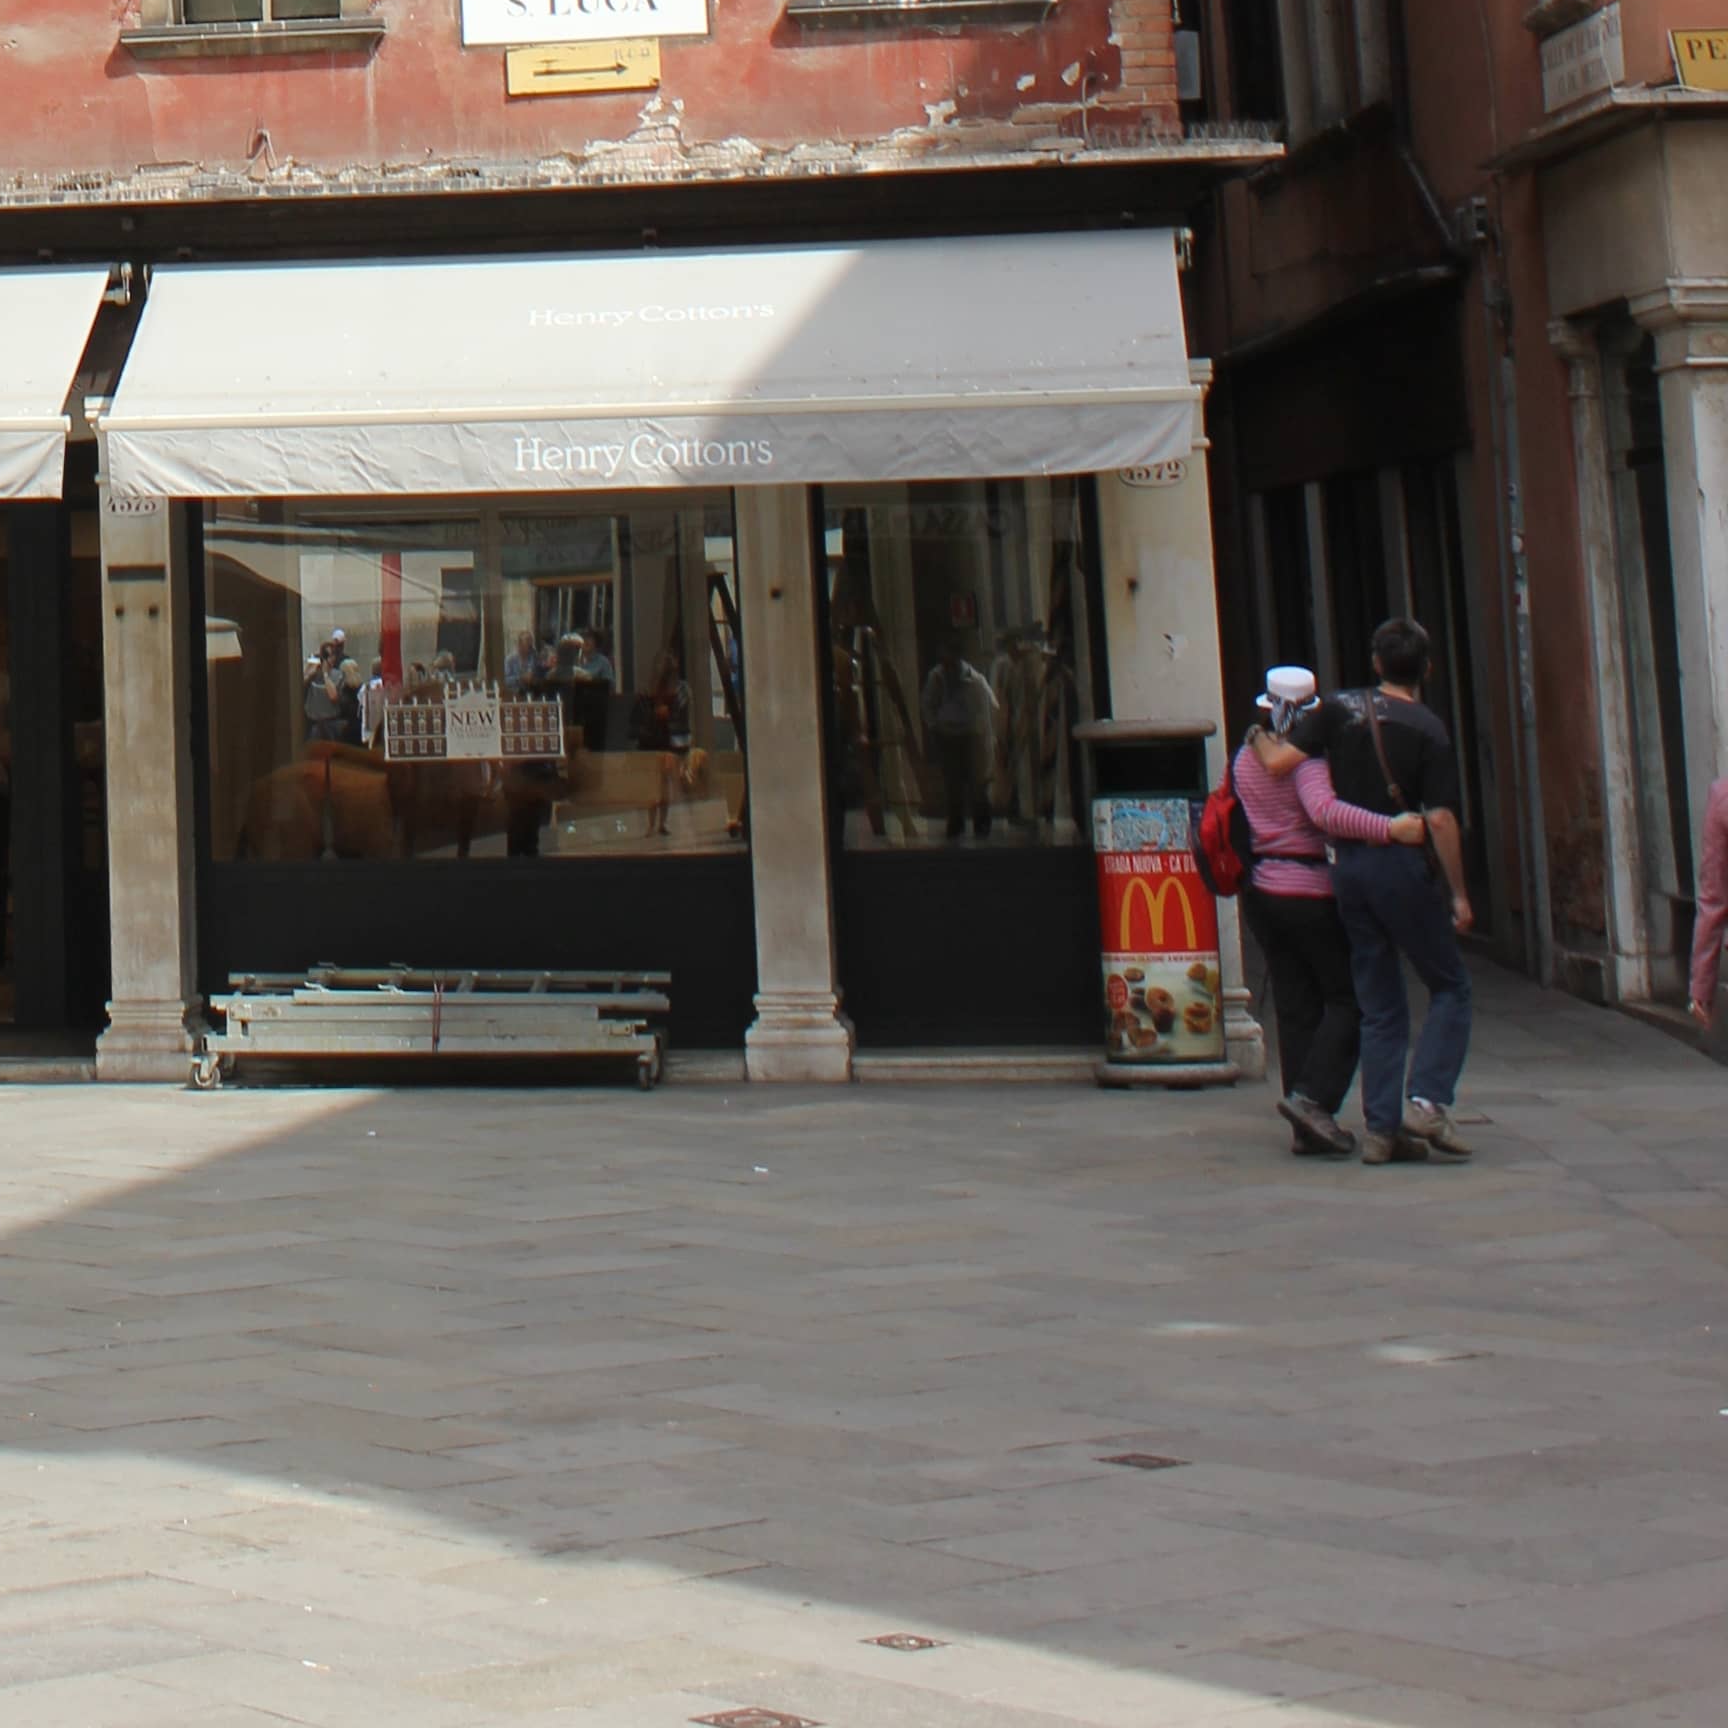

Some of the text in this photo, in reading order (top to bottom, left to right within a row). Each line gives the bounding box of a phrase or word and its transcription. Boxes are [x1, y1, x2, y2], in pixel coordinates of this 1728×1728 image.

[528, 304, 778, 327] Henry Cotton's
[512, 433, 774, 479] Henry Cotton's
[450, 709, 496, 726] NEW
[1103, 854, 1132, 874] STRADA
[1132, 854, 1163, 874] NUOVA
